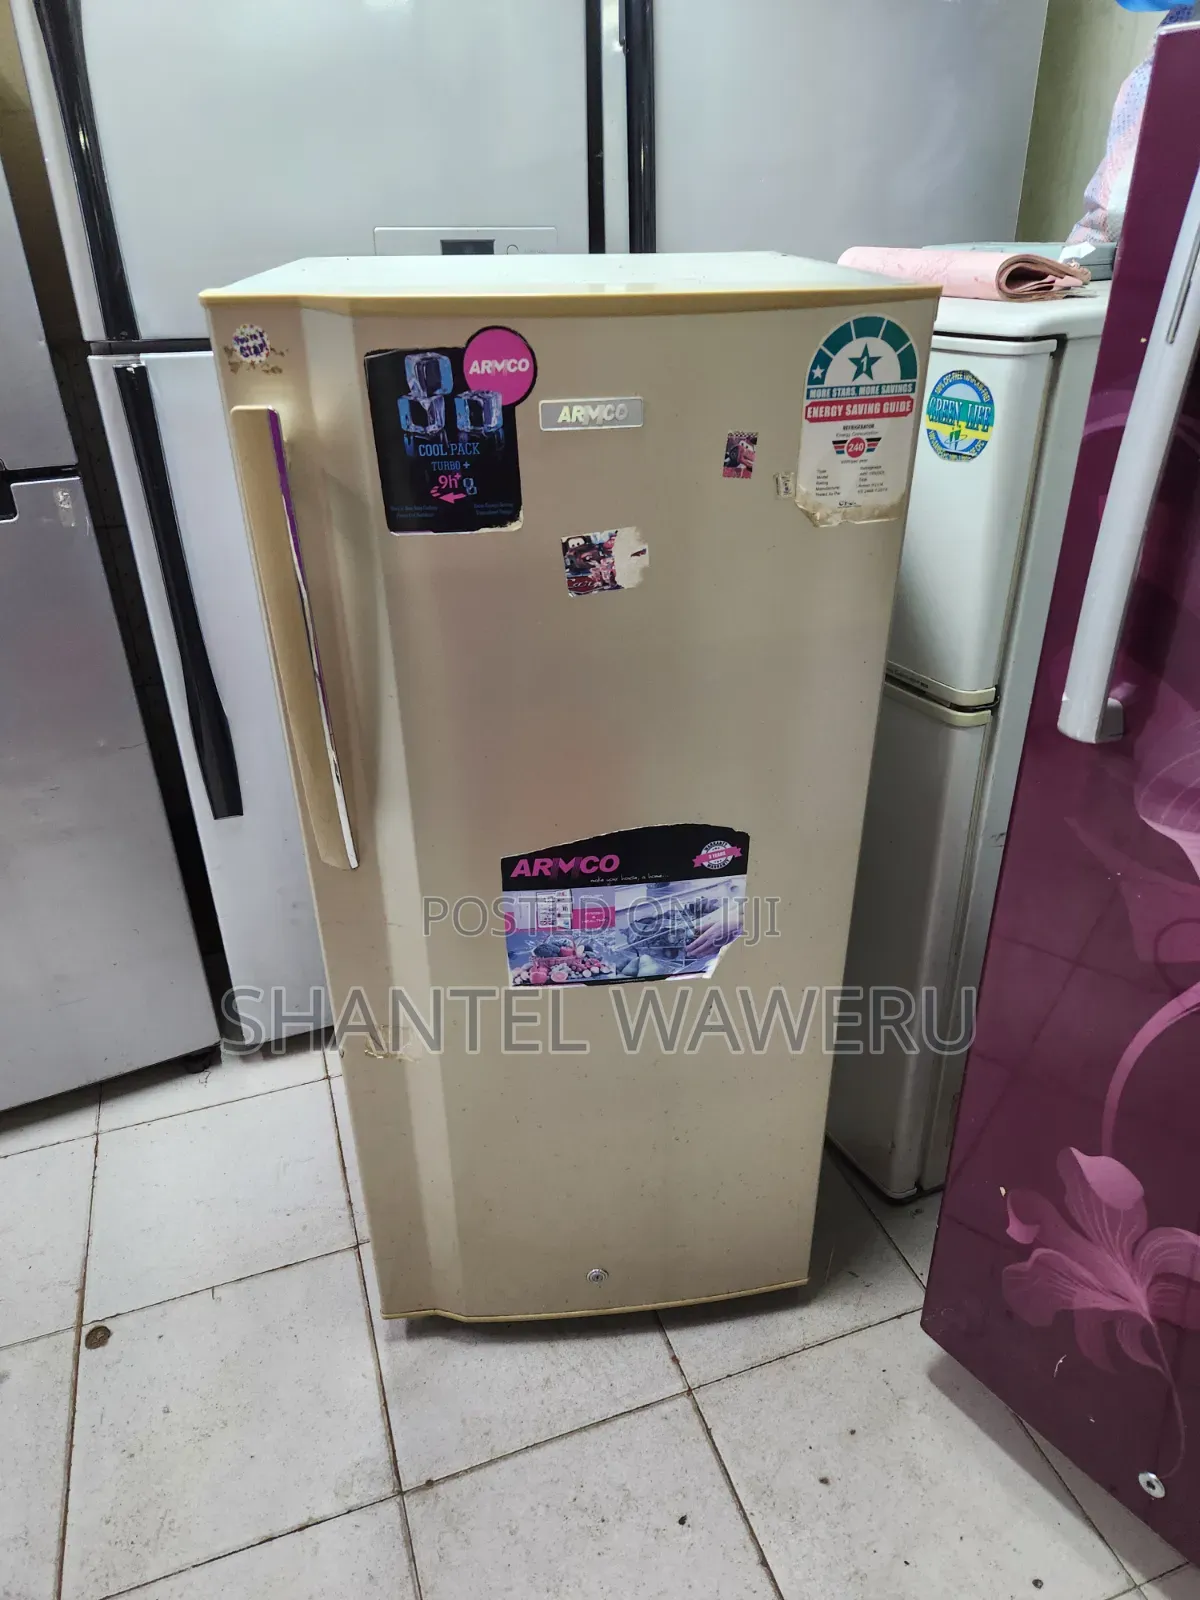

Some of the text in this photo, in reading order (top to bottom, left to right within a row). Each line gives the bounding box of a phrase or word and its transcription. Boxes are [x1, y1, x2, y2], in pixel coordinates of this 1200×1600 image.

[469, 358, 530, 376] ARMCO
[861, 355, 868, 372] 1
[809, 388, 831, 399] MORE
[859, 385, 880, 396] MORE
[881, 383, 913, 395] SAVINGS
[557, 403, 629, 425] ARMCO
[807, 400, 912, 419] ENERGY SAVING GUIDE
[928, 396, 991, 432] GREEN LIFE
[418, 442, 481, 457] COOL PACK
[848, 442, 865, 452] 240
[431, 460, 460, 471] TURBO
[510, 854, 620, 878] ARMCO
